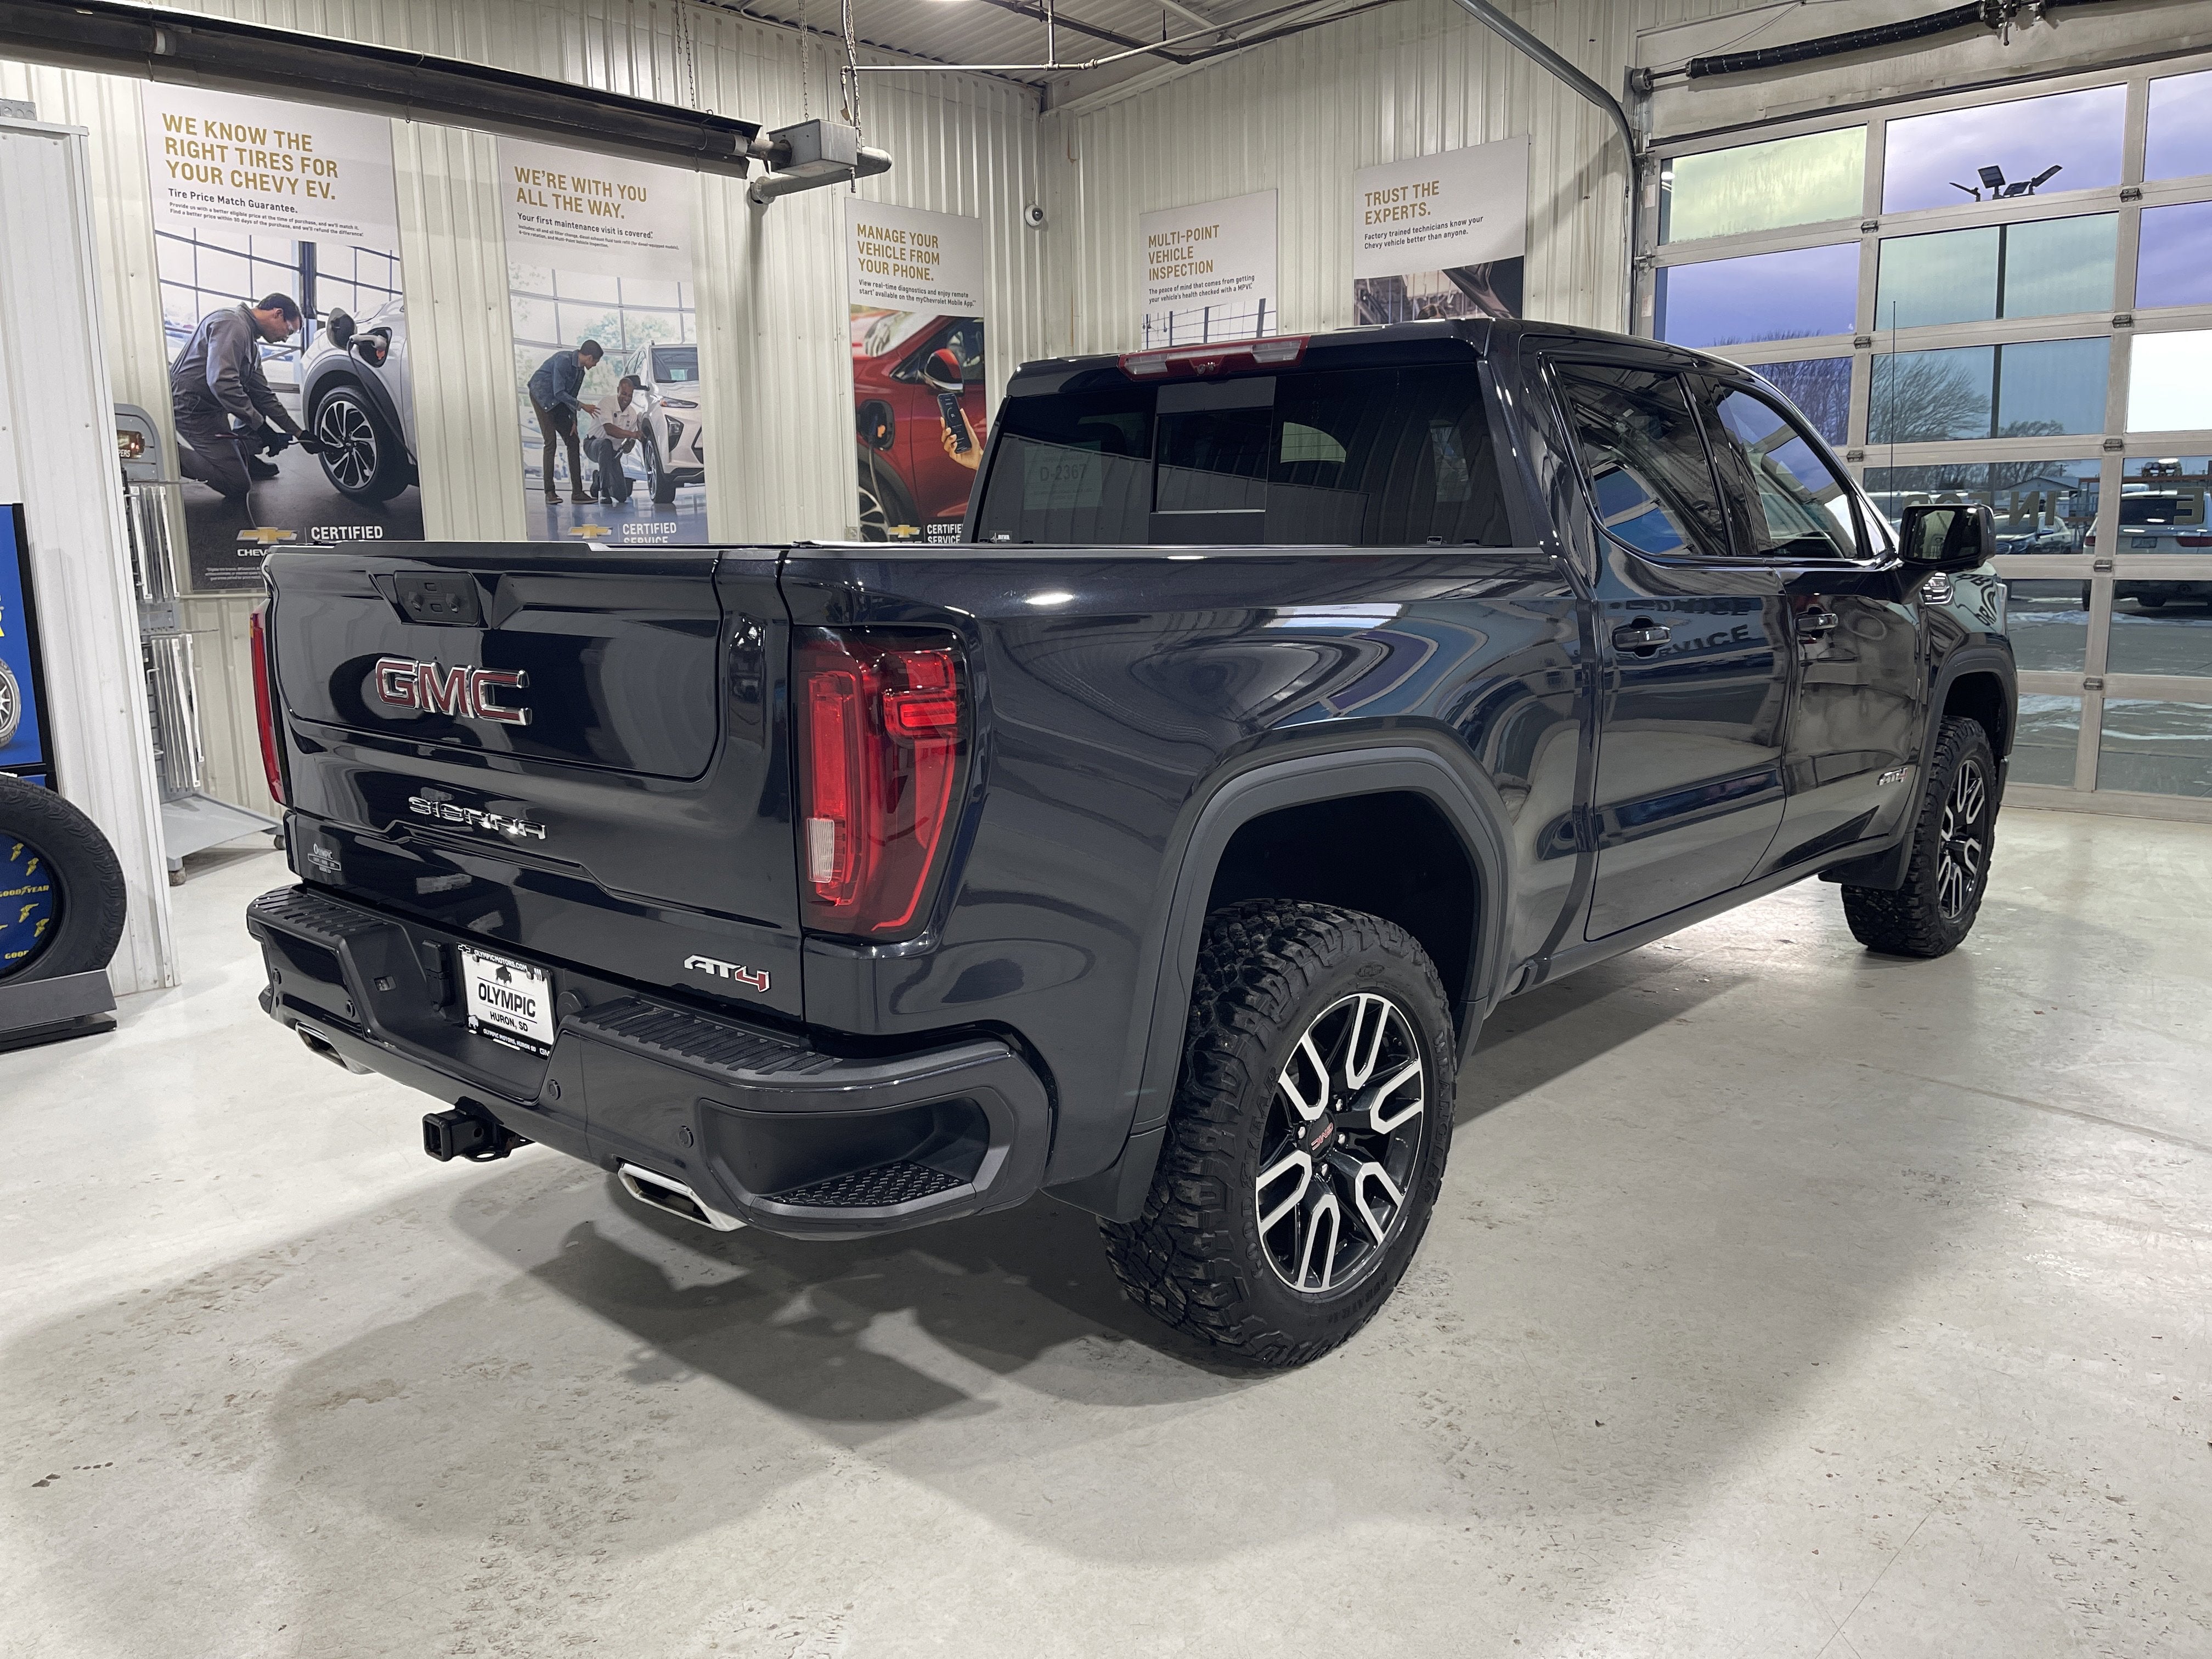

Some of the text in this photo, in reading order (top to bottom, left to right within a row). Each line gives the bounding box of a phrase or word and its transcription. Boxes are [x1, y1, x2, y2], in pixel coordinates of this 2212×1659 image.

[162, 113, 313, 152] WE KNOW THE
[165, 137, 338, 178] RIGHT TIRES FOR
[166, 160, 336, 200] YOUR CHEVY EV.
[514, 166, 647, 202] WE'RE WITH YOU
[168, 188, 298, 213] Tire Price Match Guarantee.
[517, 188, 625, 219] ALL THE WAY.
[1364, 180, 1440, 207] TRUST THE
[517, 212, 534, 222] Your
[537, 216, 552, 225] first
[555, 221, 599, 233] maintenance
[601, 226, 616, 235] visit
[1365, 201, 1431, 225] EXPERTS.
[857, 223, 939, 249] MANAGE YOUR
[1149, 224, 1220, 248] MULTI-POINT
[1364, 216, 1483, 241] Factory trained technicians know your
[1364, 228, 1469, 250] Chevy vehicle better than anyone.
[857, 241, 940, 266] VEHICLE FROM
[1148, 246, 1194, 264] VEHICLE
[858, 258, 934, 281] YOUR PHONE.
[1149, 259, 1213, 281] INSPECTION
[859, 279, 871, 287] View
[873, 281, 896, 291] real-time
[898, 285, 927, 295] diagnostics
[938, 290, 950, 298] enjoy
[1149, 296, 1160, 304] your
[1182, 291, 1198, 299] health
[1199, 289, 1220, 297] checked
[1159, 287, 1172, 295] peace
[1235, 274, 1255, 284] getting
[875, 291, 898, 300] available
[916, 296, 946, 305] myChevrolet
[311, 526, 383, 540] CERTIFIED
[623, 522, 676, 535] CERTIFIED
[927, 523, 963, 534] CERTIFIE
[375, 657, 533, 726] GMC
[1878, 767, 1908, 786] AT4
[408, 796, 547, 840] SIERRA
[474, 950, 527, 970] OLYMPICMOTORS.COM
[684, 955, 770, 992] AT4
[478, 983, 535, 1018] OLYMPIC
[483, 1028, 499, 1038] OLYMPIC
[490, 1011, 528, 1032] HURON, SD
[1311, 1122, 1334, 1151] GMC
